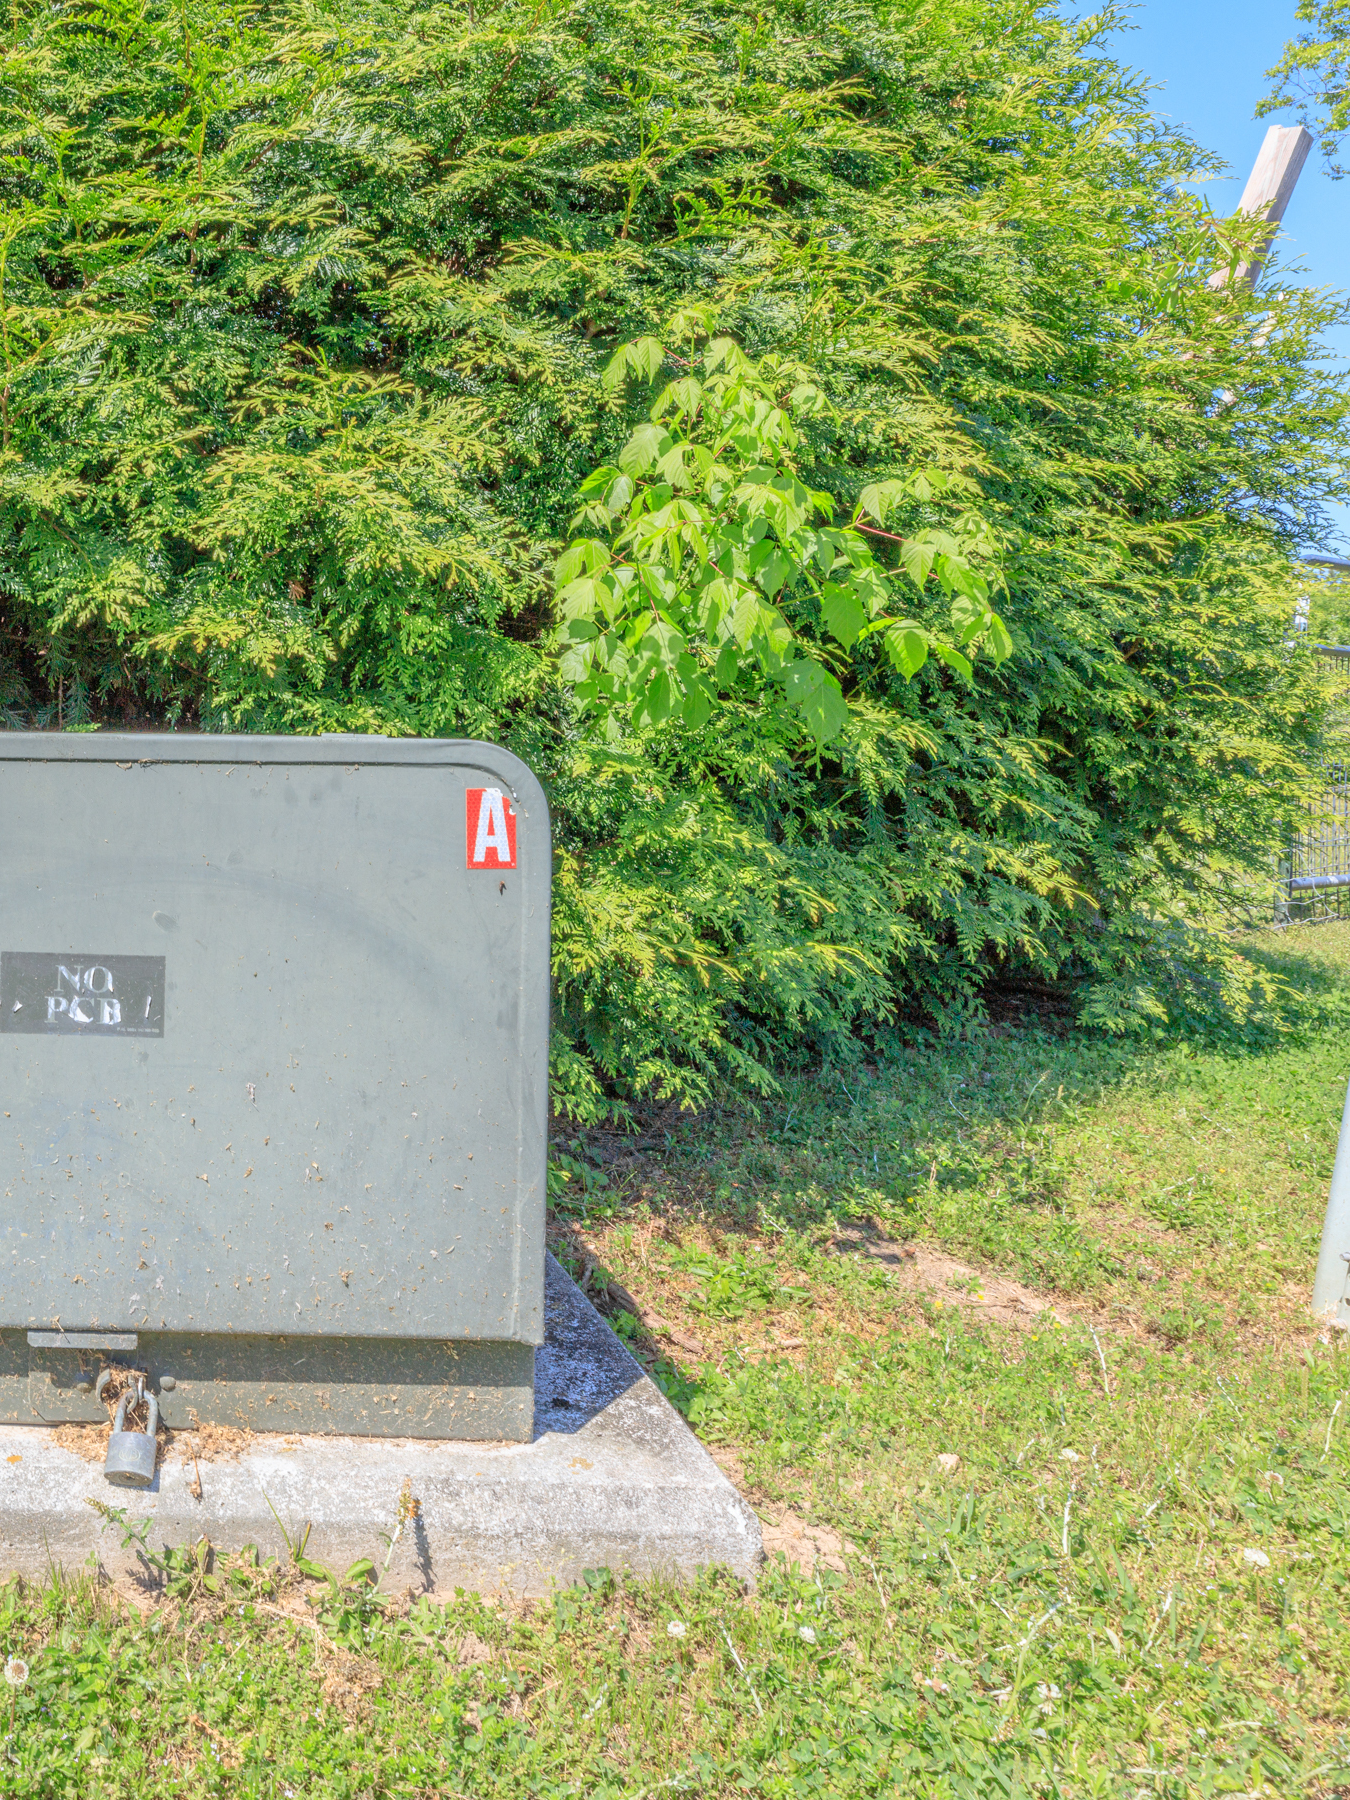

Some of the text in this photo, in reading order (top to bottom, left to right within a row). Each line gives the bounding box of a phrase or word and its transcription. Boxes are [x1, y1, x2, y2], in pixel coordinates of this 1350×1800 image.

[473, 791, 511, 862] A
[54, 965, 114, 993] NO
[44, 995, 121, 1025] PCB
